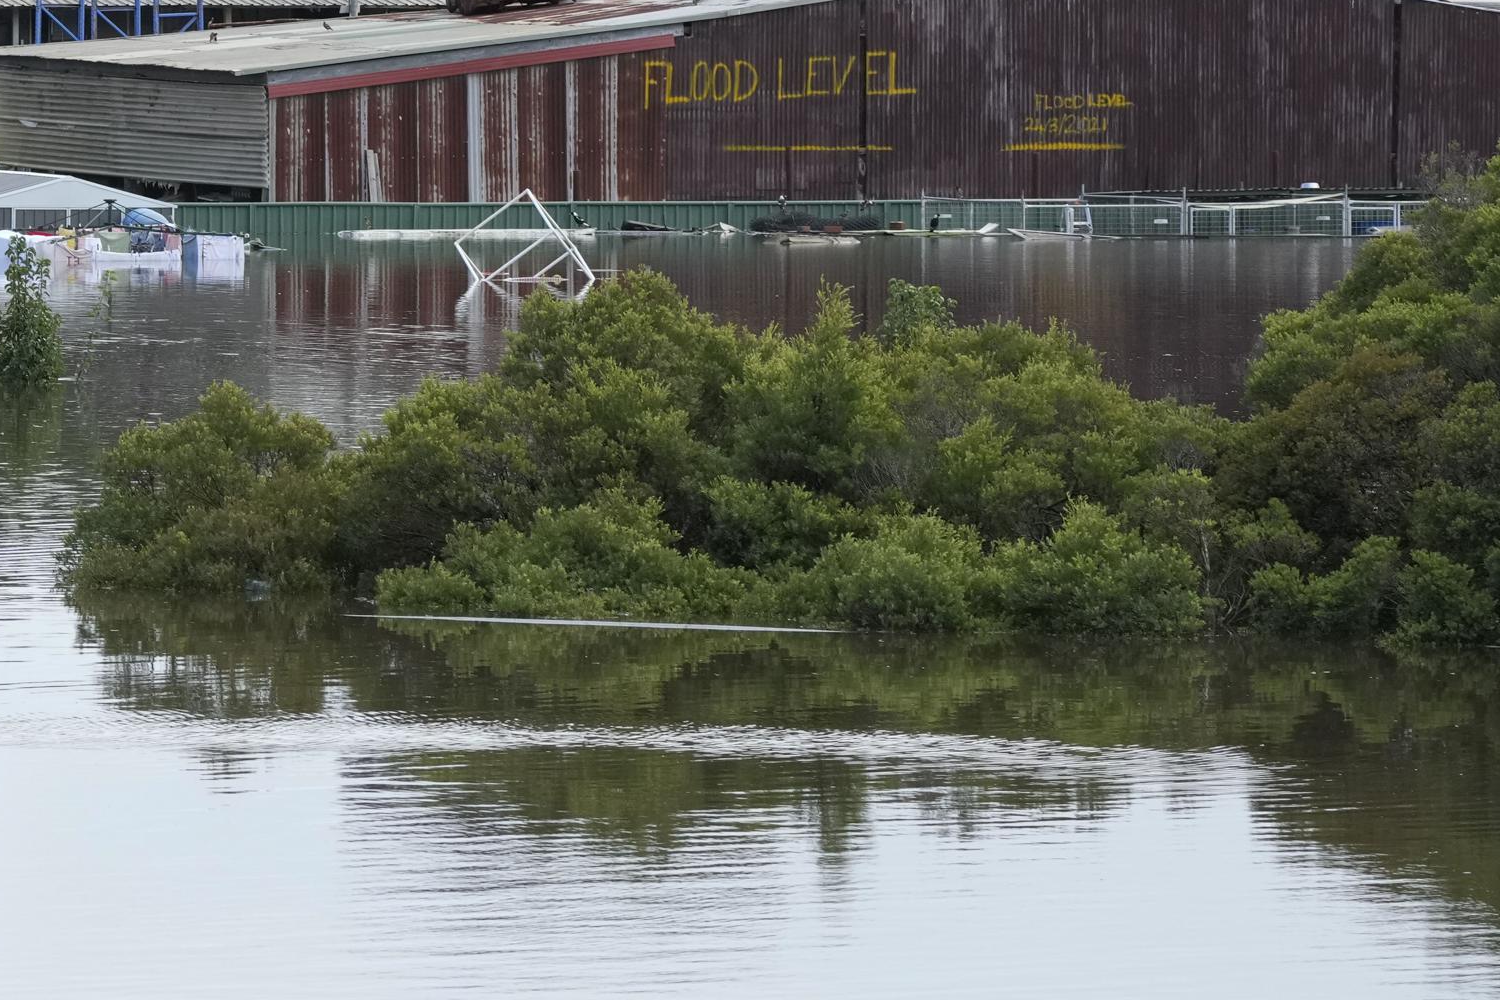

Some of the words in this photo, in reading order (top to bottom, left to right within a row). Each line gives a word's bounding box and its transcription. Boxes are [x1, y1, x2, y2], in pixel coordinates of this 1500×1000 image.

[644, 60, 759, 110] FLOOD
[777, 51, 917, 101] LEVEL
[1034, 93, 1085, 110] FLOOD
